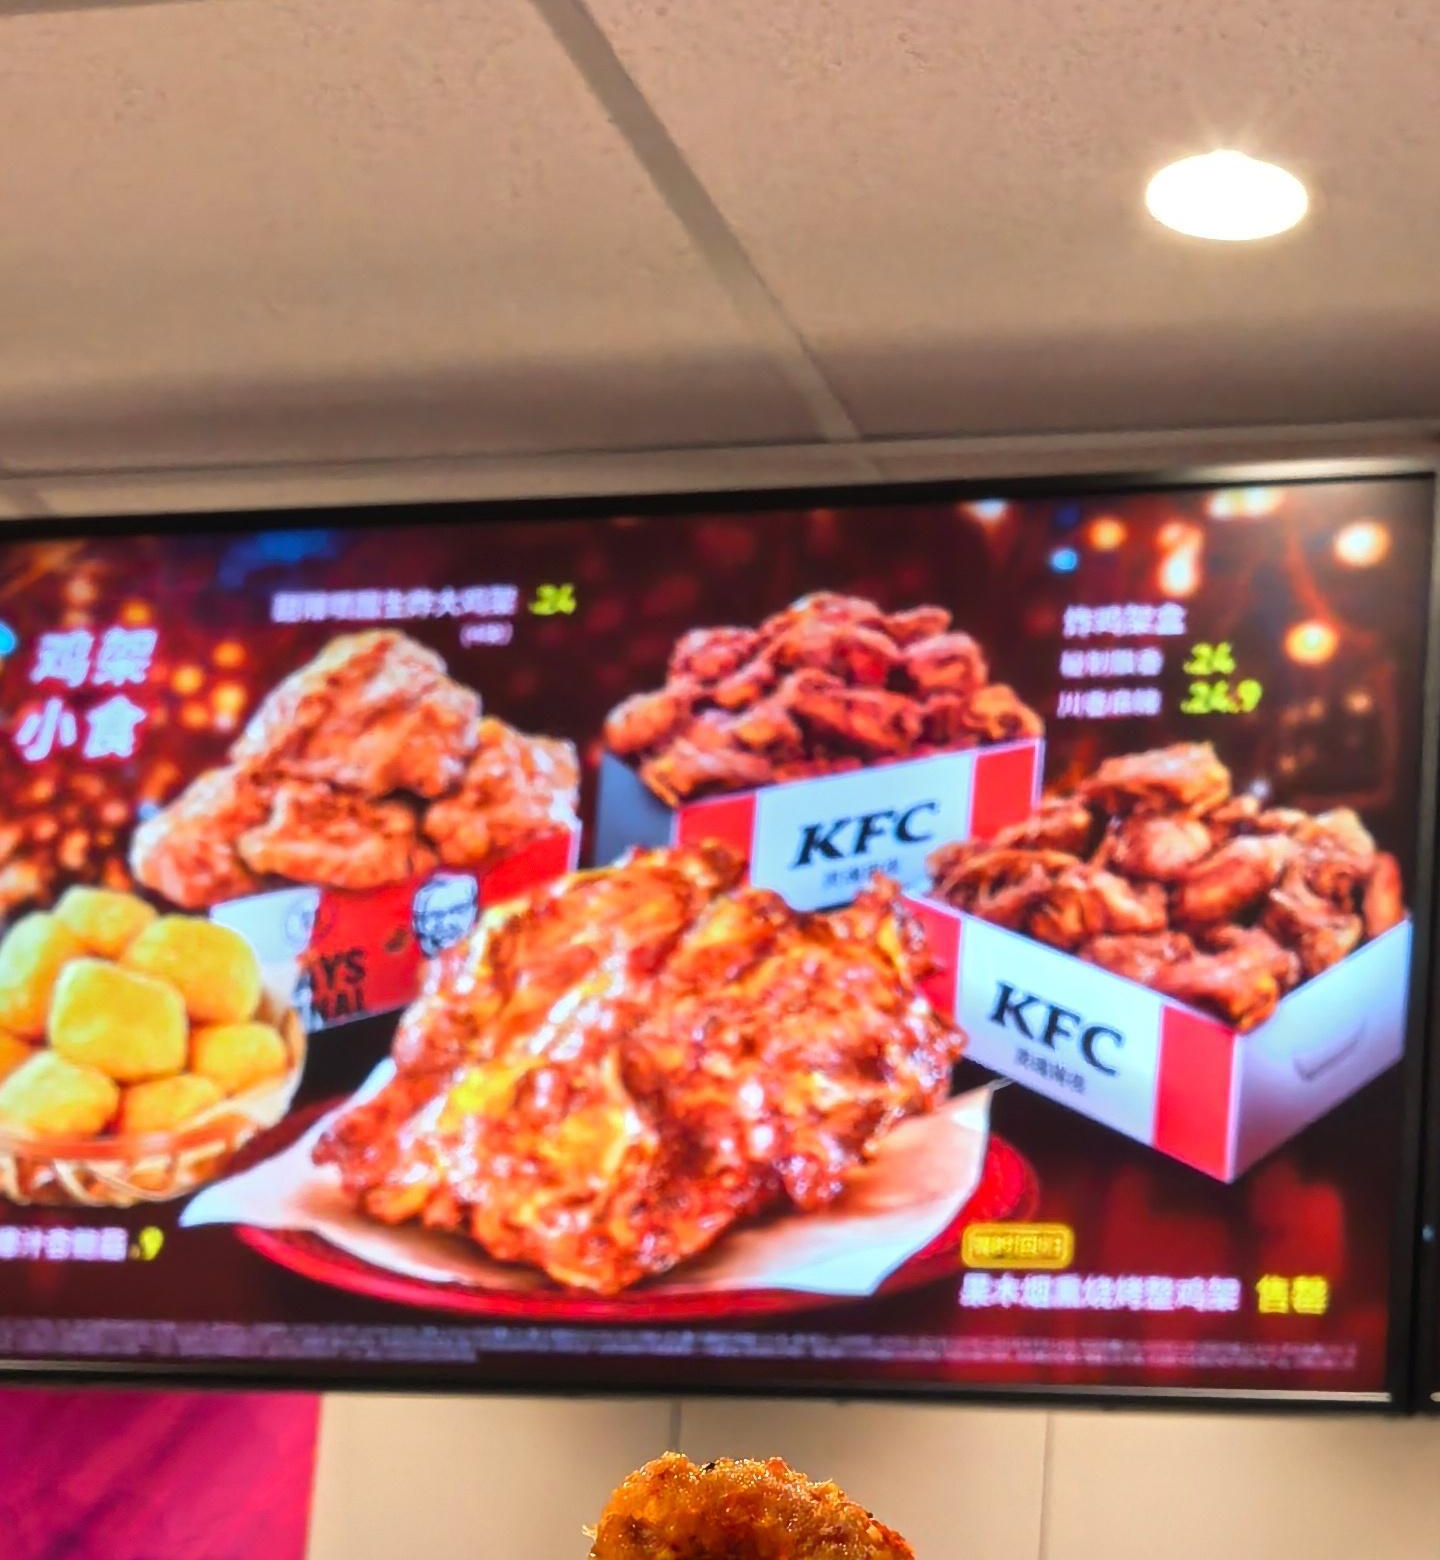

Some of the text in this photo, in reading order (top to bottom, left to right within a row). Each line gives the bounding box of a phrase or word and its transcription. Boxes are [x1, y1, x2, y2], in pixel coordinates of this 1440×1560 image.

[30, 626, 159, 687] 鸡架
[16, 694, 147, 762] 小食
[793, 800, 940, 869] KFC
[988, 978, 1125, 1077] KFC
